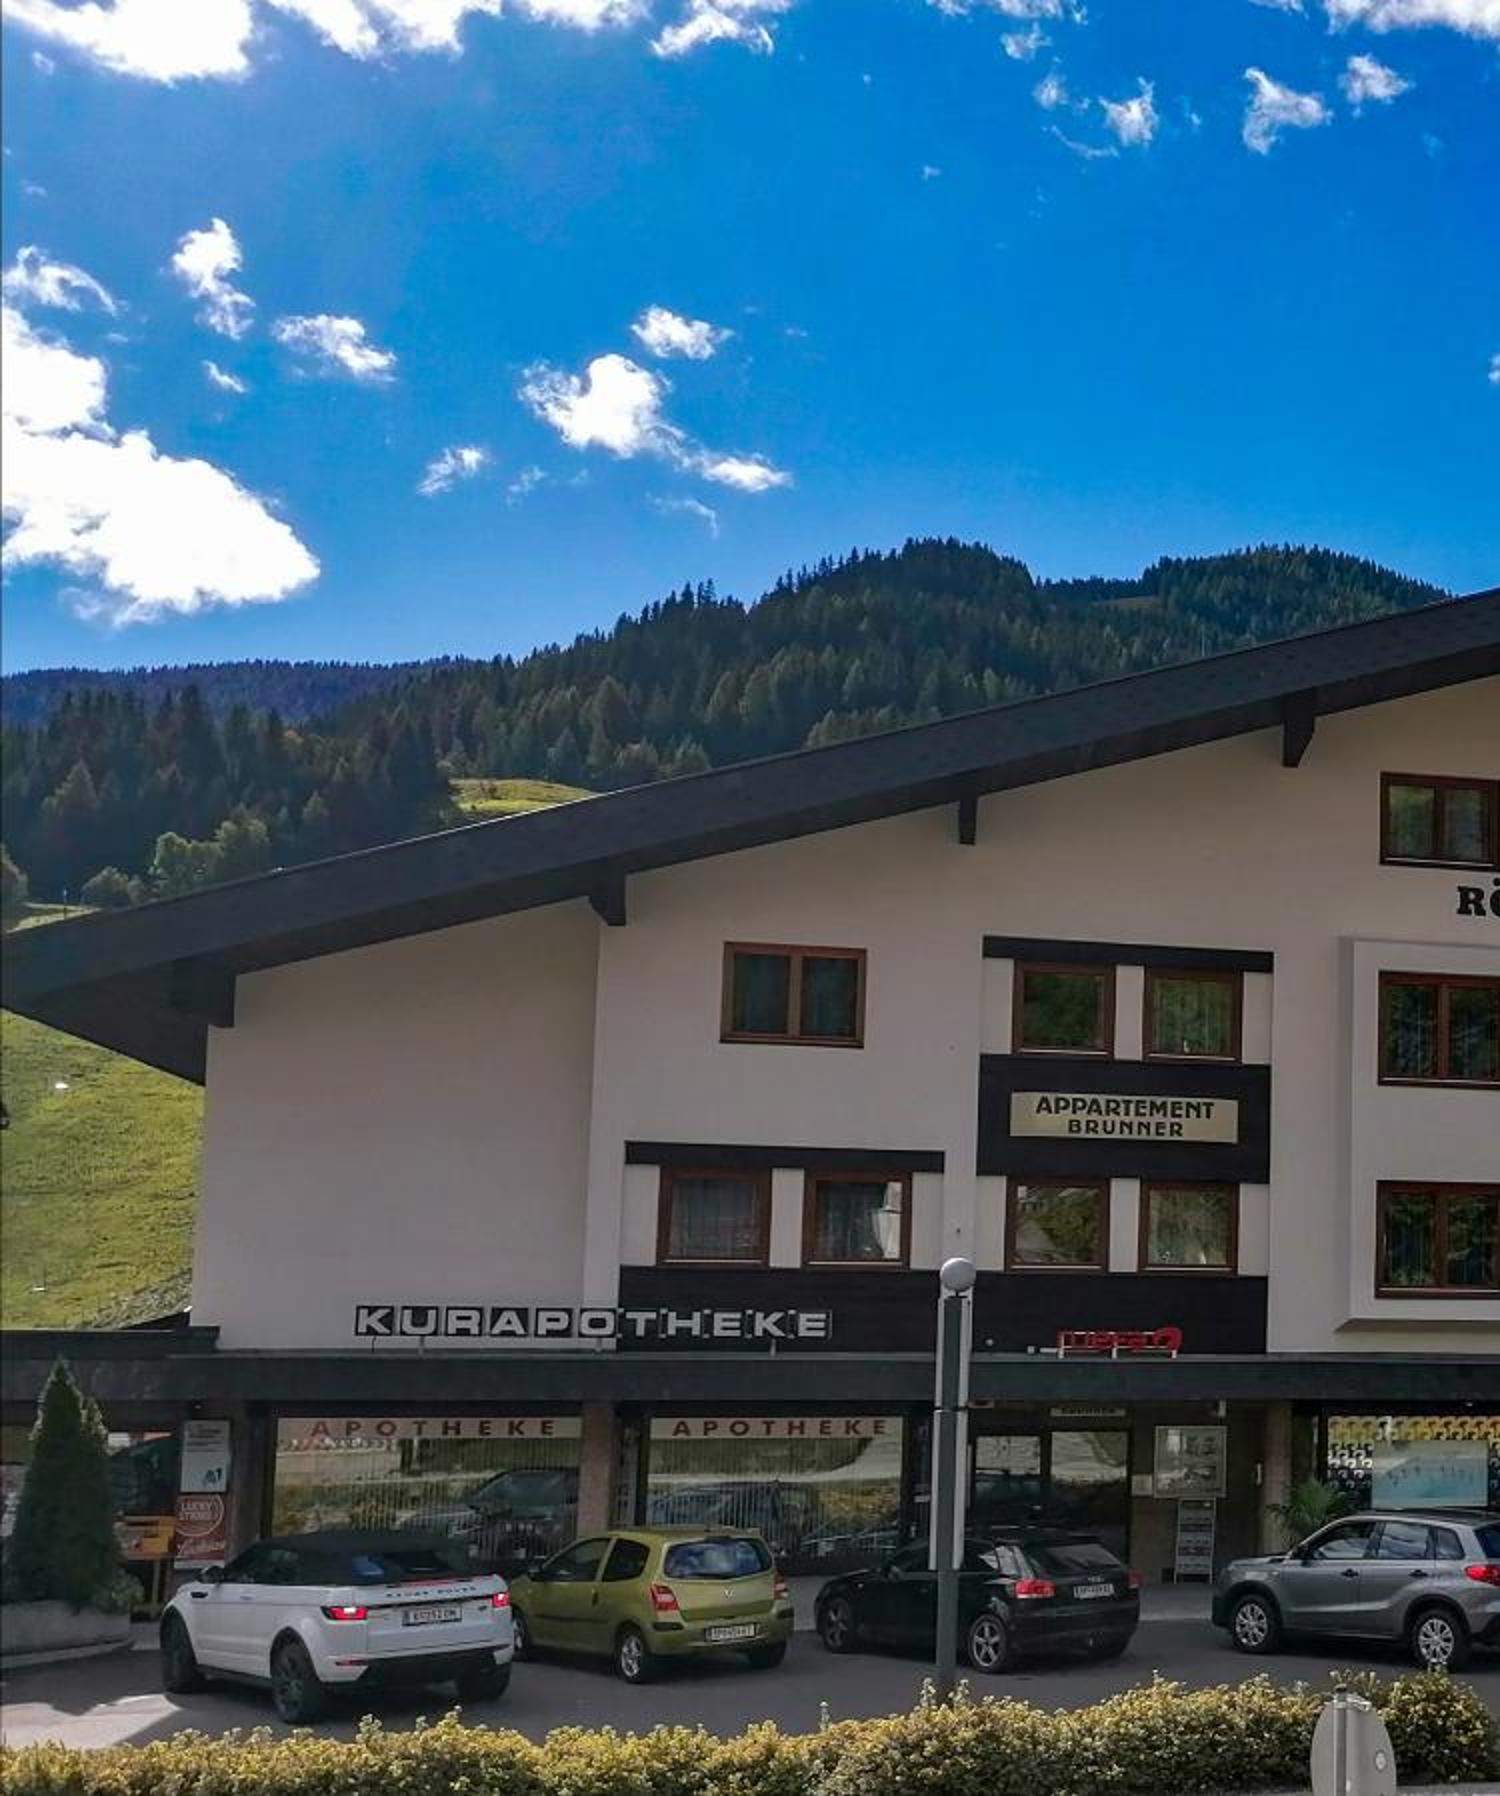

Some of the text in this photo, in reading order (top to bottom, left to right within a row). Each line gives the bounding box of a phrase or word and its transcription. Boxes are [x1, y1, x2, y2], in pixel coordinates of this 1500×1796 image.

[1035, 1096, 1215, 1119] APPARTEMENT
[1067, 1119, 1184, 1137] BRUNNER
[357, 1308, 828, 1338] KURAPOTHEKE
[309, 1419, 556, 1437] APOTHEKE
[672, 1419, 887, 1437] APOTHEKE
